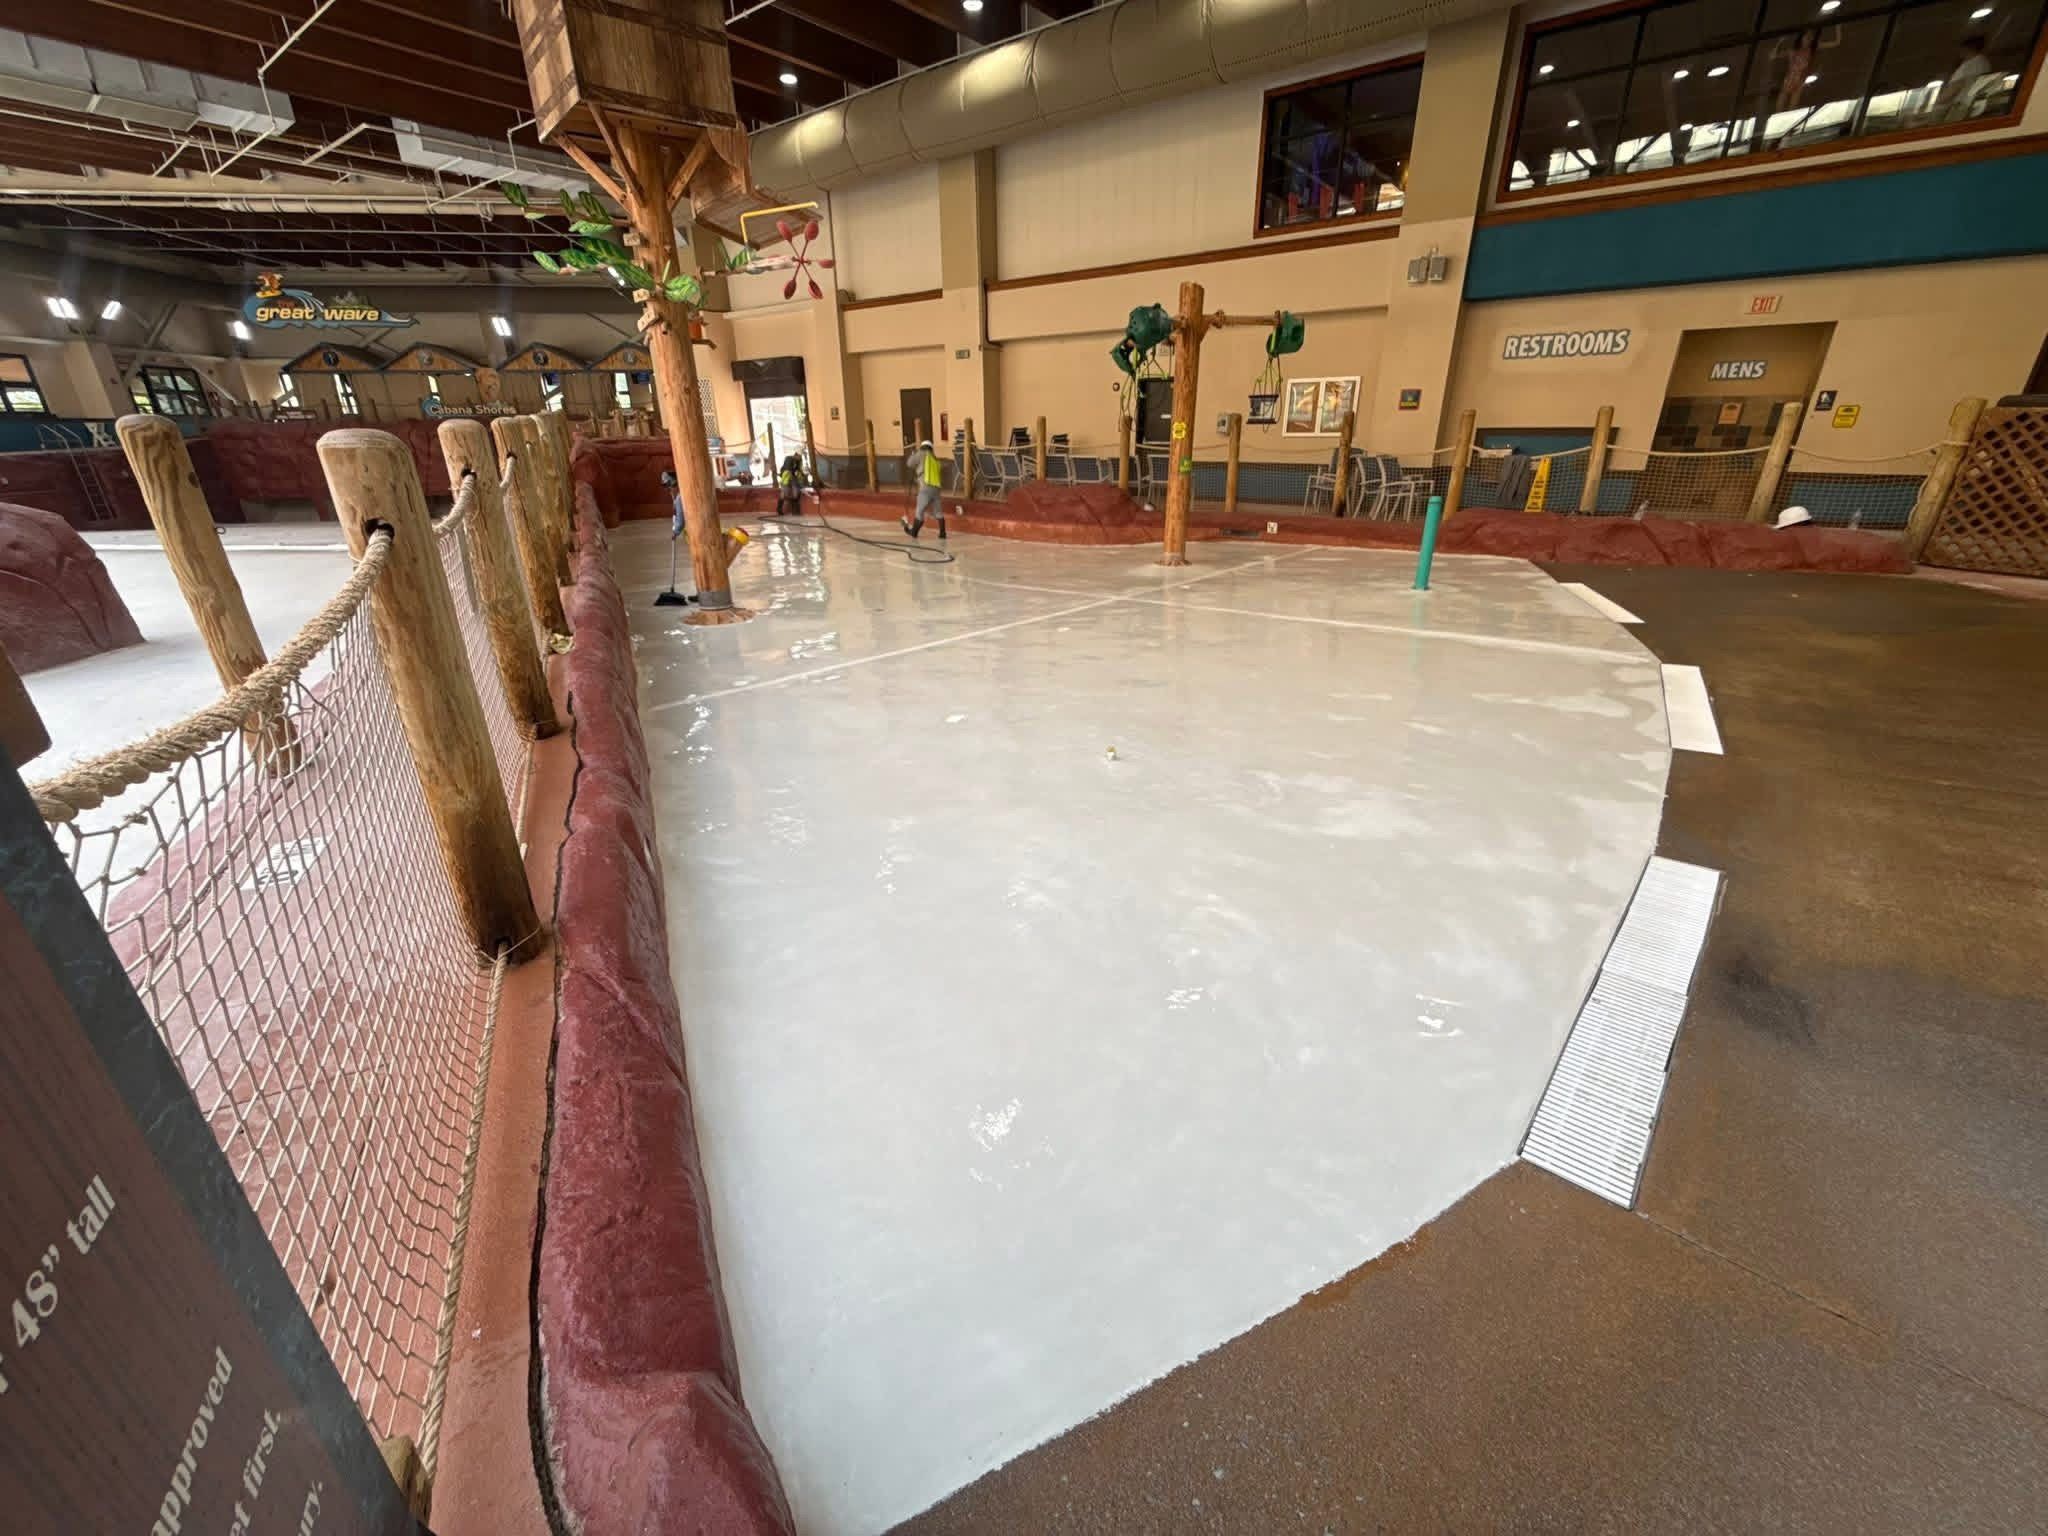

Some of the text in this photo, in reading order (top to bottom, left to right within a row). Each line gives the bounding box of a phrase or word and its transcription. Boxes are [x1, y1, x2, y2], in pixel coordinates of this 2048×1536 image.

[256, 306, 380, 321] great wave
[1751, 295, 1776, 313] EXIT
[1503, 329, 1630, 359] RESTROOMS
[1710, 361, 1766, 380] MENS
[430, 405, 517, 415] Cabana Shores
[66, 1174, 116, 1255] tall
[243, 1408, 281, 1499] first.
